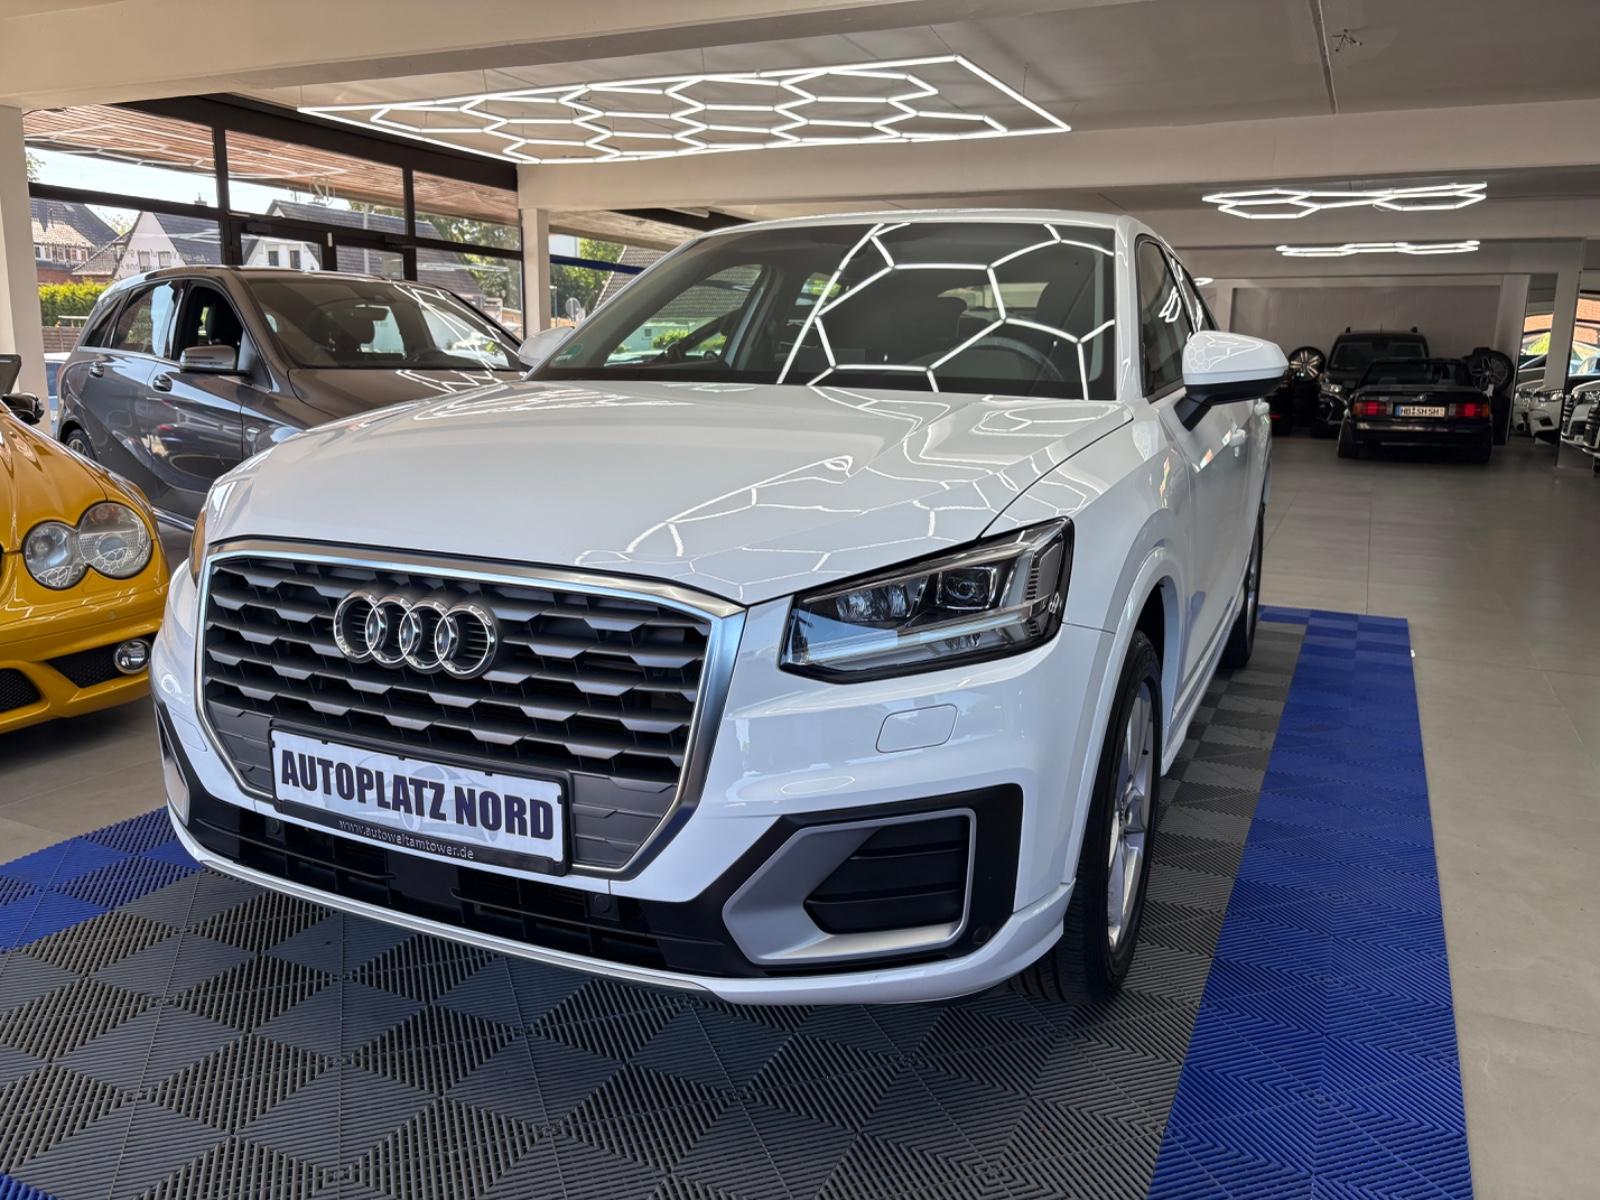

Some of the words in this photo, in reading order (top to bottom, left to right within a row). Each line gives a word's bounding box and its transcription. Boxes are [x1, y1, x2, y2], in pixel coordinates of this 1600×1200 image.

[281, 749, 447, 821] AUTOPLATZ
[455, 785, 554, 840] NORD
[338, 819, 474, 860] www.autoweltamtower.de
